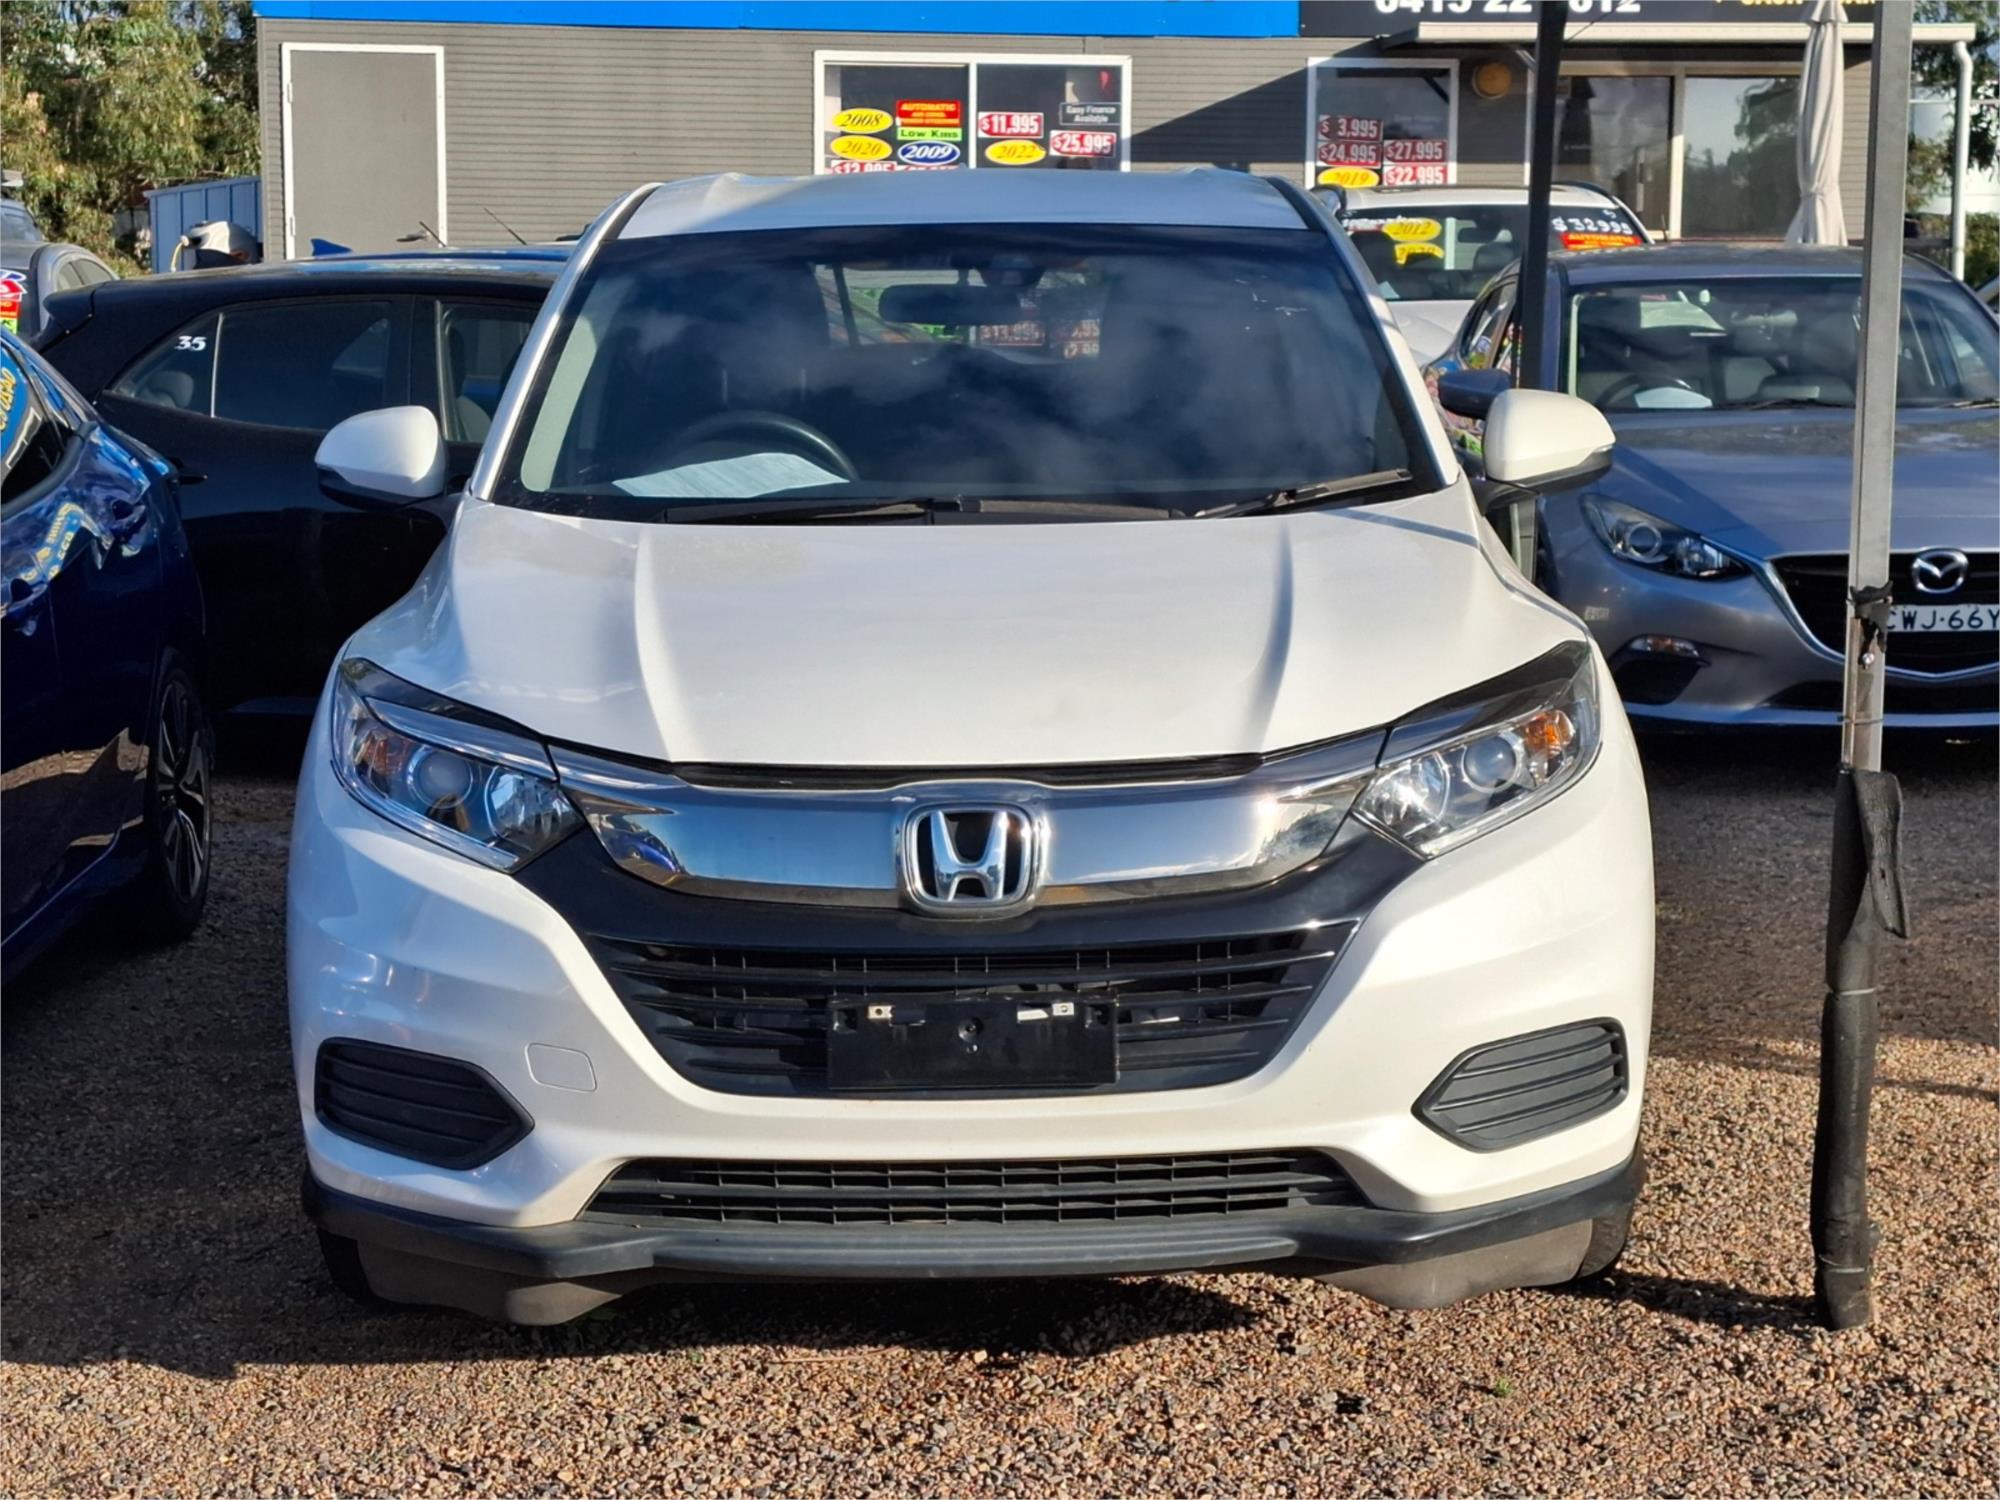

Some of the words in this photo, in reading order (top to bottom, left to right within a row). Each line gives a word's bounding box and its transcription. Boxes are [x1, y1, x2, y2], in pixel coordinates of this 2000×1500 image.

[840, 113, 883, 127] 2008
[841, 141, 881, 156] 2020
[905, 145, 953, 159] 2009
[996, 145, 1038, 159] 2022
[1393, 221, 1431, 235] 2012
[174, 335, 207, 351] 35
